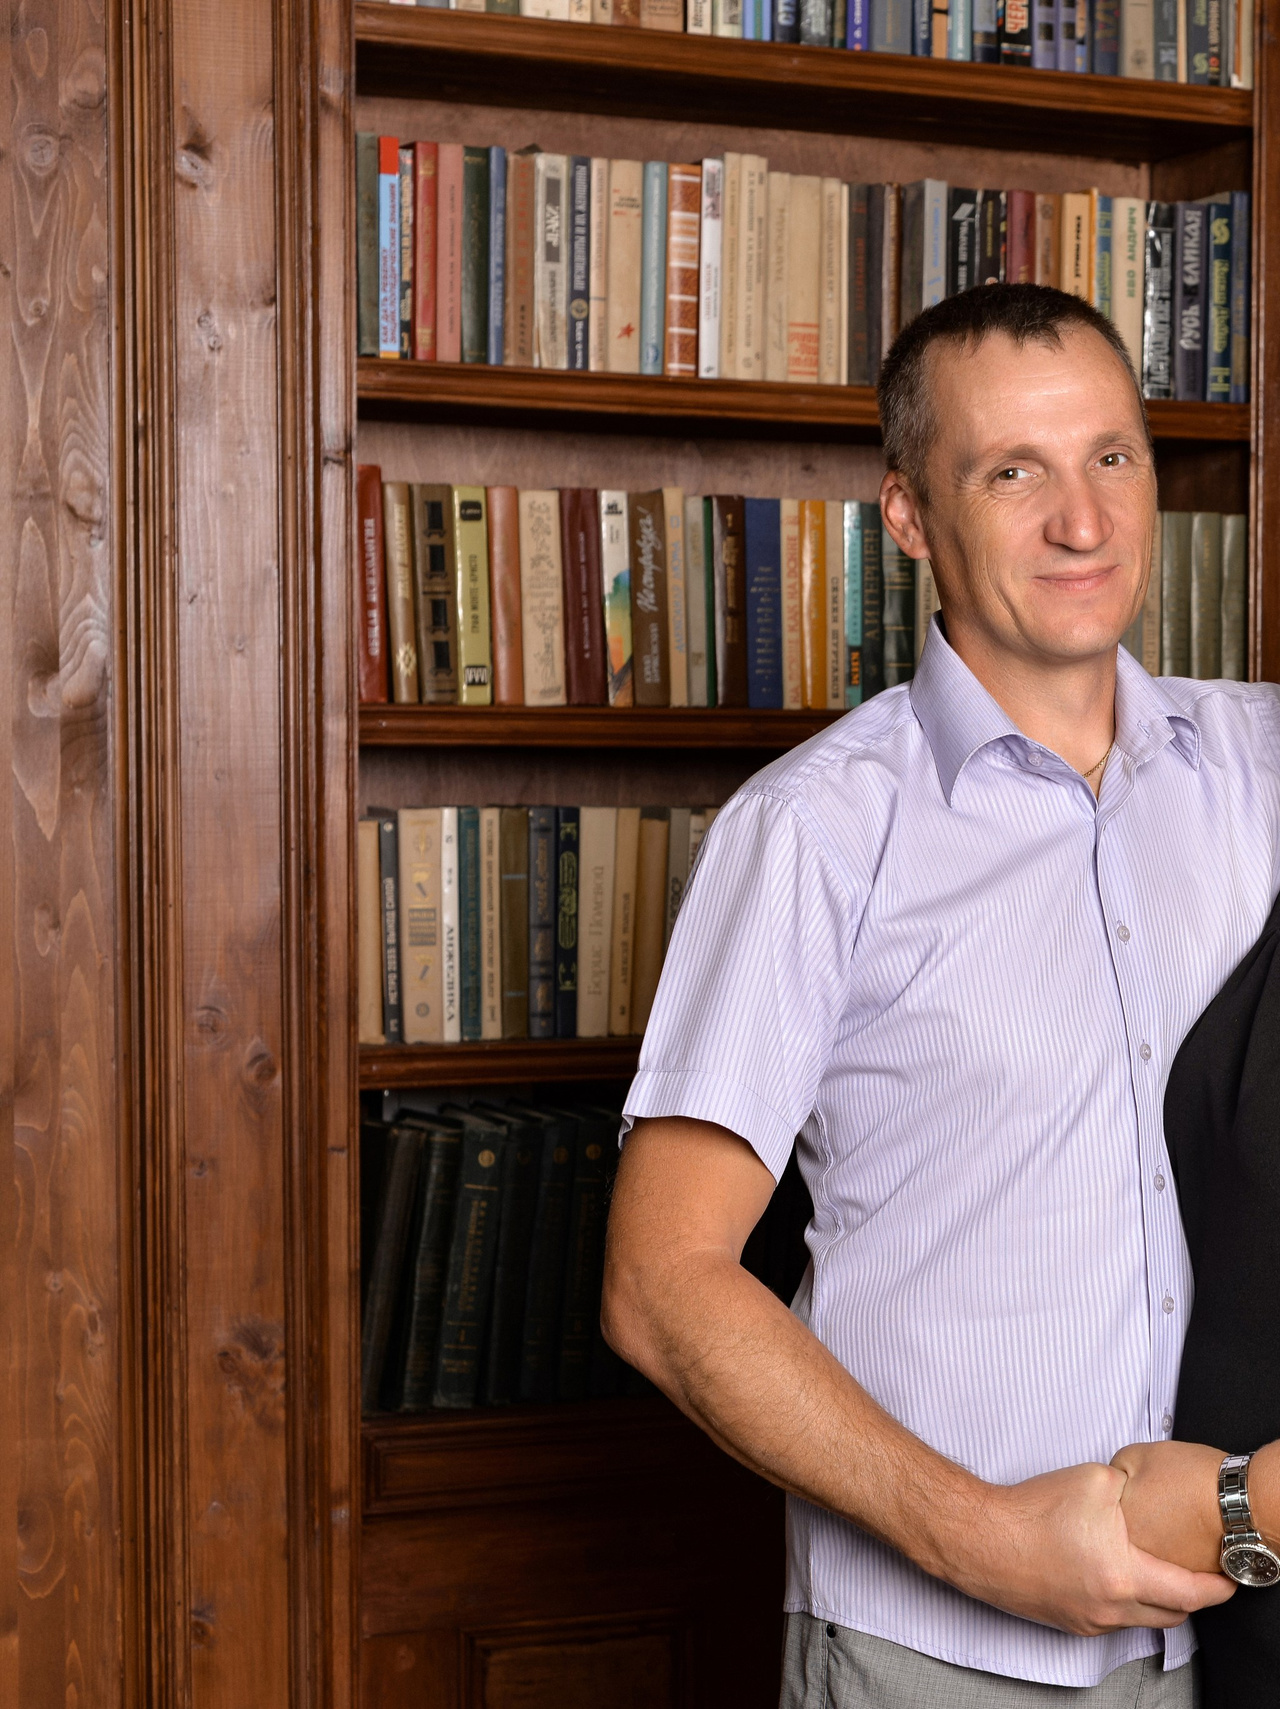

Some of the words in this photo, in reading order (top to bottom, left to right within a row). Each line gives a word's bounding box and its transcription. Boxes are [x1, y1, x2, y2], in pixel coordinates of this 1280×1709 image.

[1007, 0, 1028, 33] ЧЕР
[1126, 206, 1138, 262] АНДРИЧ
[1126, 269, 1136, 298] ИВО
[364, 517, 378, 603] ПСИХОЛОГИЯ
[366, 608, 380, 657] ОБЩАЯ
[470, 613, 480, 634] ГРАФ
[787, 604, 799, 633] КАК
[587, 865, 604, 937] Полевой
[387, 972, 398, 1006] МЕТРО
[445, 922, 455, 1023] АНЖЕЛИКА
[587, 943, 605, 996] Борис
